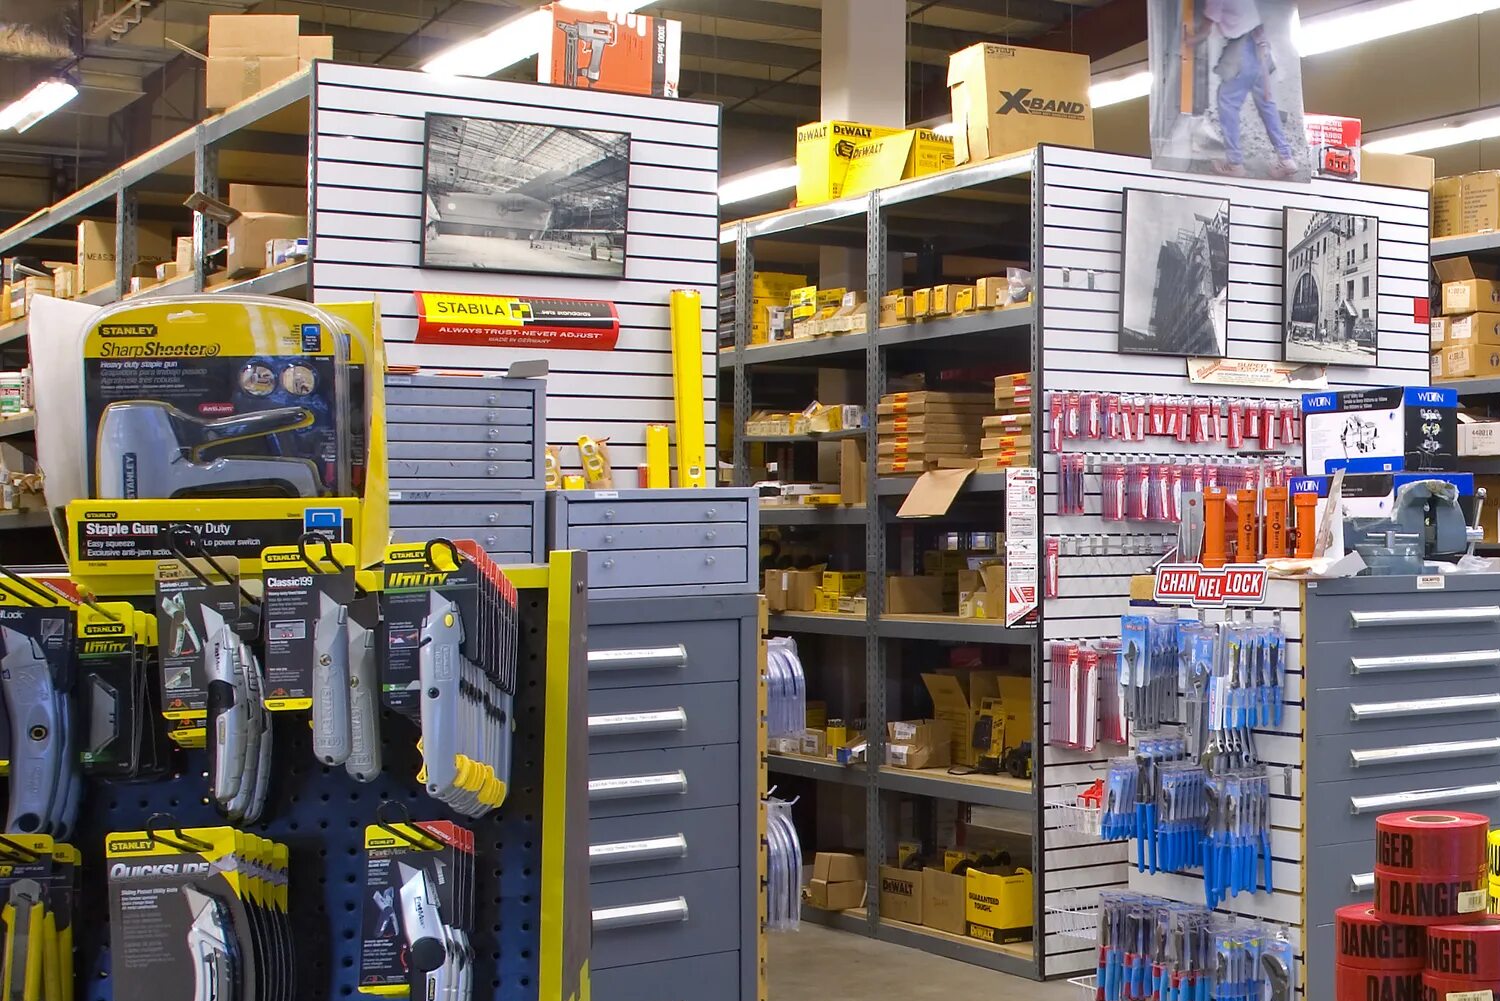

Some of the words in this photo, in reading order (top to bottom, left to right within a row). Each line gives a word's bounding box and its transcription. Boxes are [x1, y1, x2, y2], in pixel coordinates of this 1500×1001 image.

[437, 301, 506, 316] STABILA
[102, 326, 155, 336] STANLEY
[438, 326, 483, 335] ALWAYS
[86, 522, 129, 536] Staple
[132, 522, 158, 535] Gun
[205, 523, 231, 536] Duty
[236, 537, 261, 546] switch
[267, 554, 301, 562] STANLEY
[86, 625, 123, 634] STANLEY
[111, 841, 152, 851] STANLEY
[1341, 922, 1419, 959] DANGER
